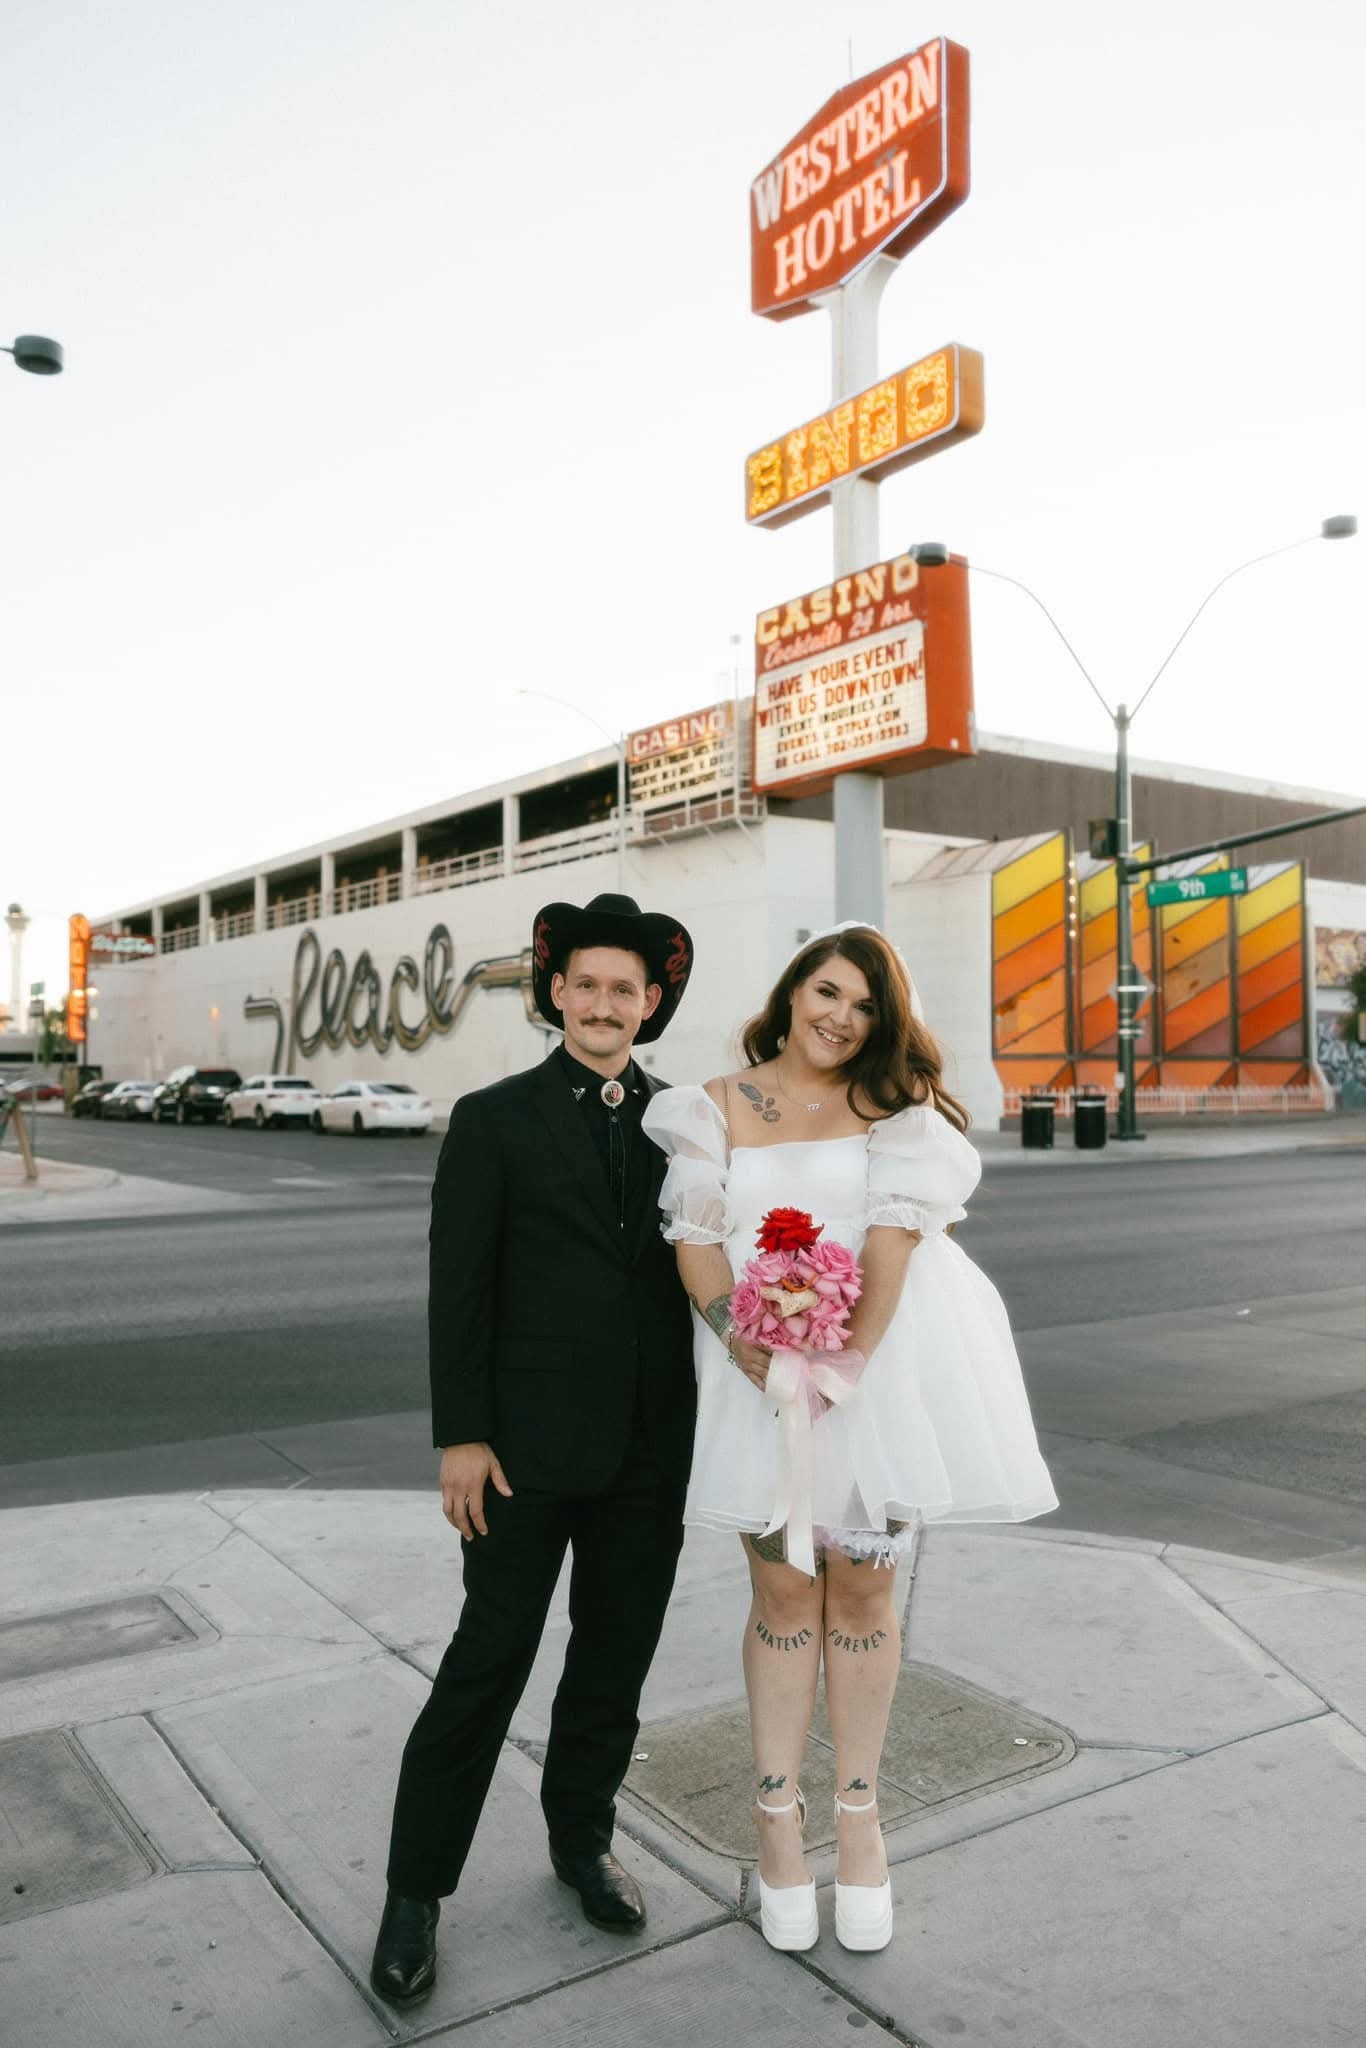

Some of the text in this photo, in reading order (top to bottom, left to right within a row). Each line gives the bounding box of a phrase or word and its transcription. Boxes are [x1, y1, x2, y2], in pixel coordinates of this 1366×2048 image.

[752, 38, 941, 232] WESTERN
[773, 150, 921, 297] HOTEL
[749, 353, 948, 517] BINGO
[757, 553, 919, 645] CASINO
[758, 652, 924, 727] WITH US DOWNTOWN!
[768, 639, 907, 701] HAVE YOUR EVENT
[632, 709, 727, 756] CASINO
[780, 717, 812, 738] EVENT
[883, 693, 894, 706] AT
[793, 747, 820, 765] CALL
[1178, 880, 1206, 898] 9th
[828, 1628, 887, 1653] FOREVER
